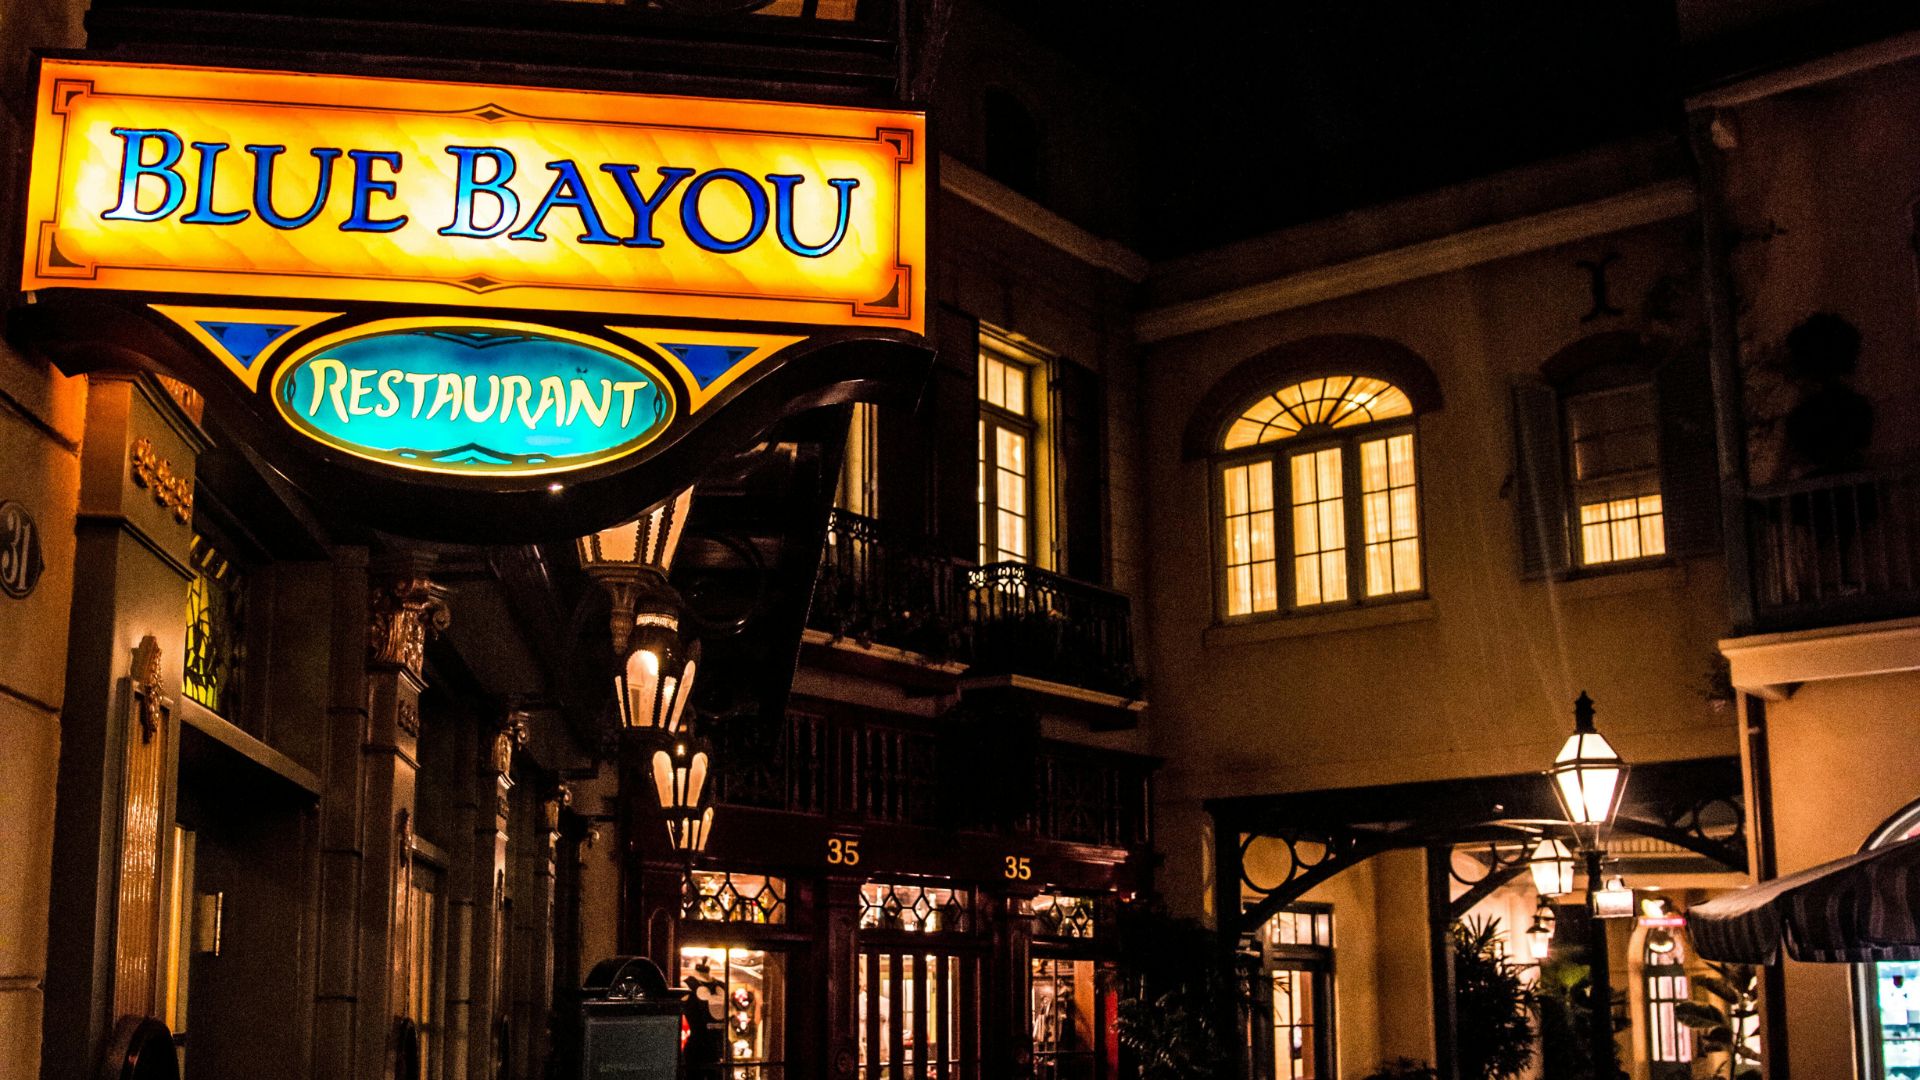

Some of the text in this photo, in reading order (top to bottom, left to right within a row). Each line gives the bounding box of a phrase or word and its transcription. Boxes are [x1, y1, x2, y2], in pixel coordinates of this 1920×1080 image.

[103, 126, 860, 258] BLUE BAYOU
[308, 357, 649, 430] RESTAURANT
[827, 838, 860, 866] 35
[1004, 855, 1032, 881] 35
